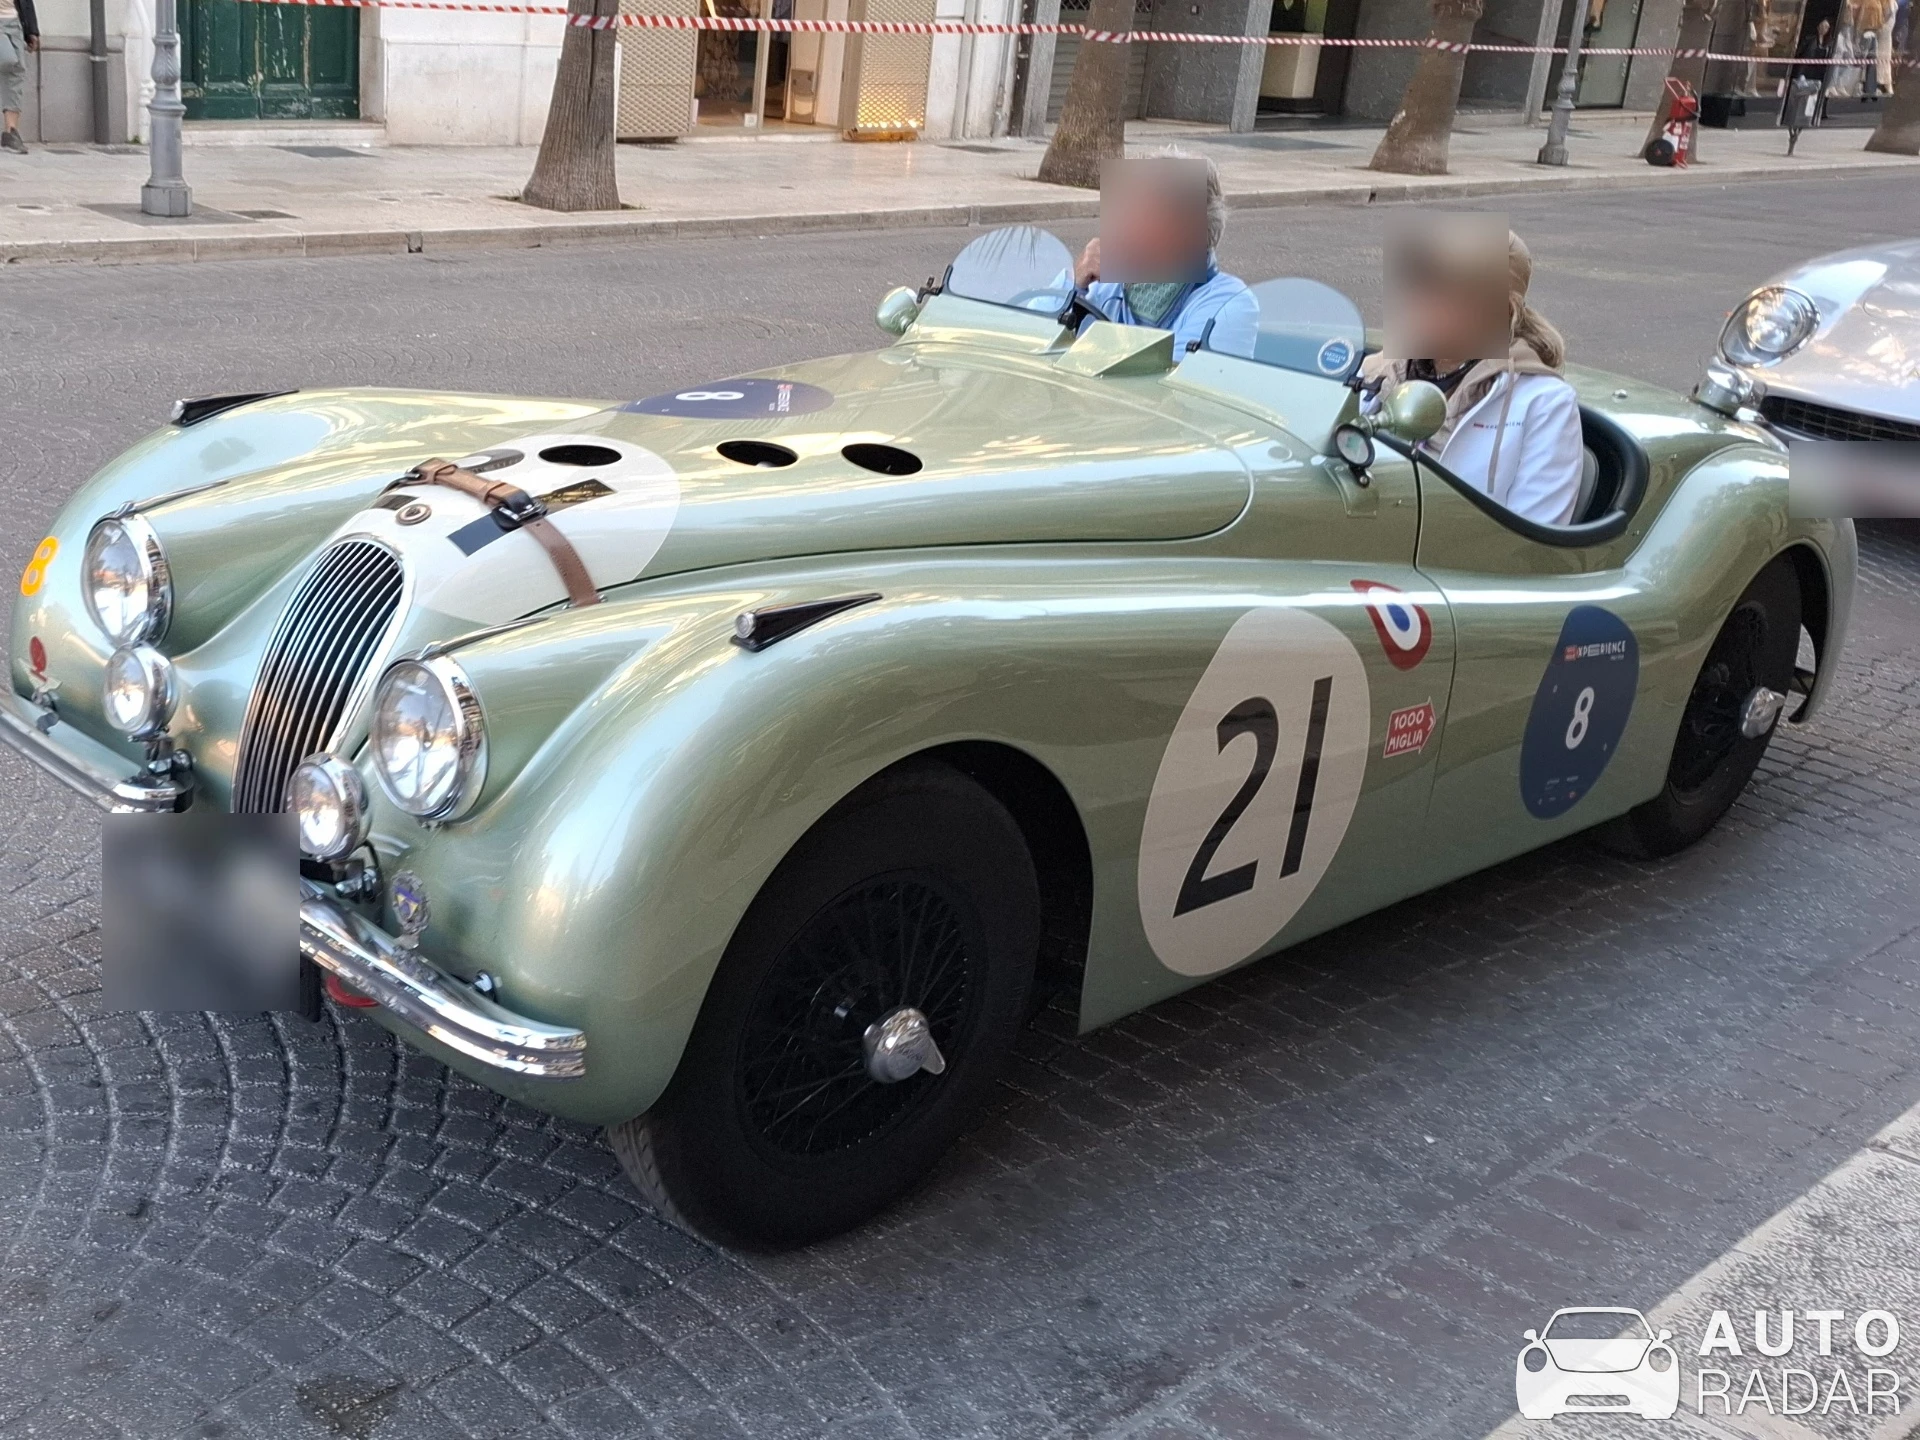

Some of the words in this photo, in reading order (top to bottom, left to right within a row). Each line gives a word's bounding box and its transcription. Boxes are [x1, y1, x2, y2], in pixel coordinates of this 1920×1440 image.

[20, 535, 60, 597] 8
[1387, 729, 1423, 752] MIGLIA
[1394, 709, 1425, 730] 1000
[1565, 686, 1595, 750] 8
[1172, 675, 1334, 918] 21
